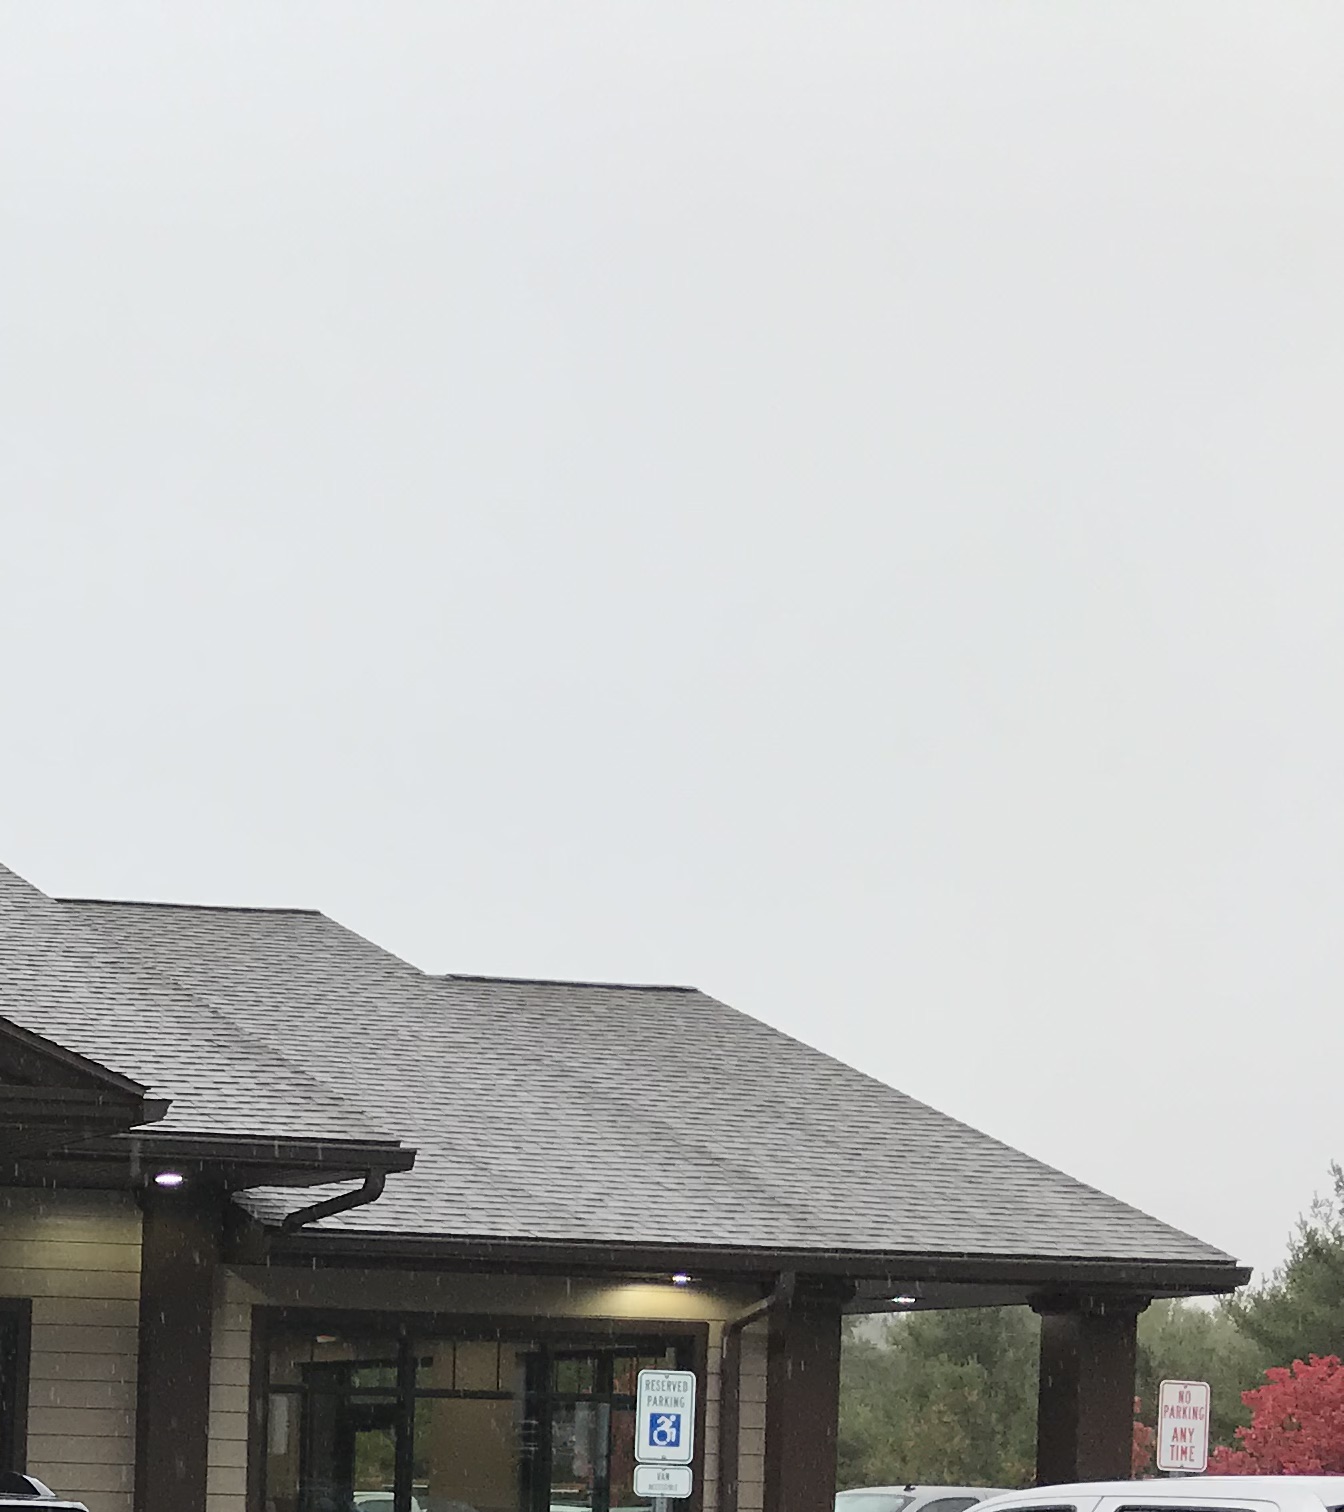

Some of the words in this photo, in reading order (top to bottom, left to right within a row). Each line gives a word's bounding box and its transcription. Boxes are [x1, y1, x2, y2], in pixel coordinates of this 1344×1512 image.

[645, 1379, 688, 1392] RESERVED
[647, 1395, 685, 1408] PARKING
[1178, 1390, 1191, 1403] NO
[1163, 1404, 1205, 1420] PARKING
[1172, 1427, 1195, 1443] ANY
[1169, 1444, 1196, 1462] TIME
